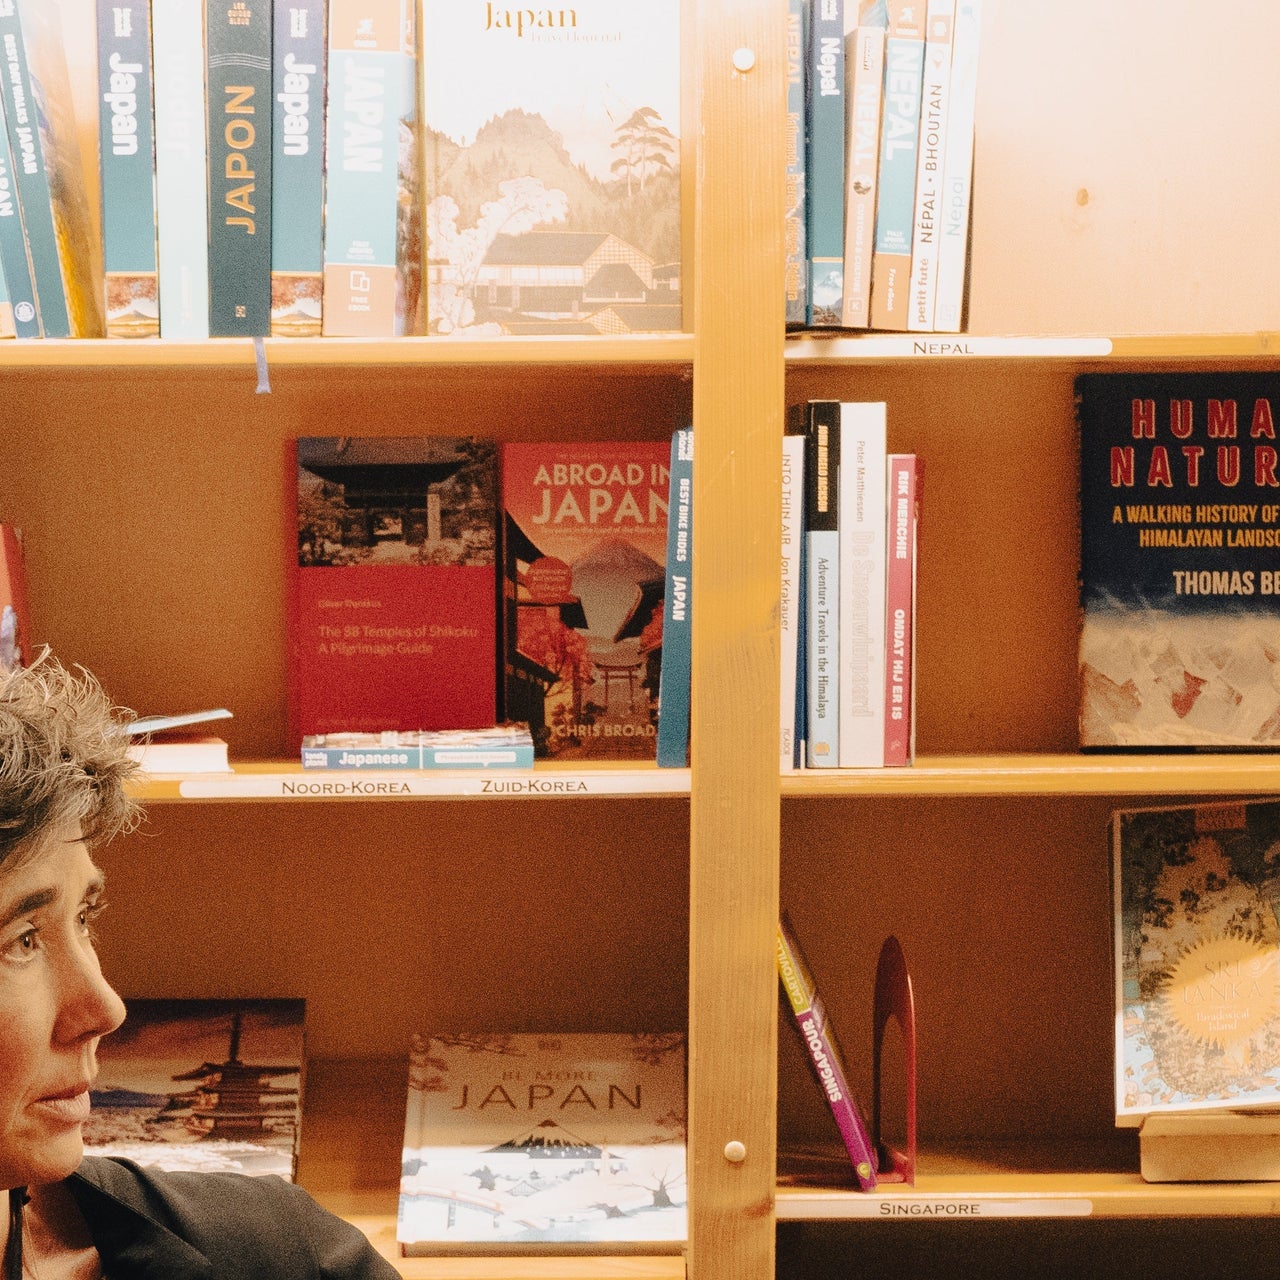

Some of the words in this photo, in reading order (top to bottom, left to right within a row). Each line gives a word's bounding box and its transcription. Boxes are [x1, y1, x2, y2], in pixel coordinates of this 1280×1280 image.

[484, 1, 577, 36] Japan
[820, 38, 839, 96] Nepal
[104, 52, 143, 156] Japan
[281, 53, 316, 156] Japan
[343, 62, 384, 173] JAPAN
[925, 84, 942, 171] BHOUTAN
[225, 86, 255, 236] JAPON
[921, 198, 935, 244] NÉPAL
[913, 342, 974, 354] NEPAL
[534, 464, 644, 487] ABROAD
[1112, 507, 1123, 523] A
[1126, 505, 1191, 524] WALKING
[1196, 506, 1259, 523] HISTORY
[1262, 506, 1280, 523] OF
[1139, 529, 1223, 548] HIMALAYAN
[1173, 571, 1254, 595] THOMAS
[556, 725, 600, 737] CHRIS
[604, 725, 655, 737] BROAD
[339, 752, 407, 766] Japanese
[282, 781, 411, 794] NOORD-KOREA
[481, 780, 588, 793] ZUID-KOREA
[805, 1017, 841, 1103] SINGAPOUR
[452, 1086, 641, 1110] JAPAN
[880, 1203, 981, 1215] SINGAPORE
